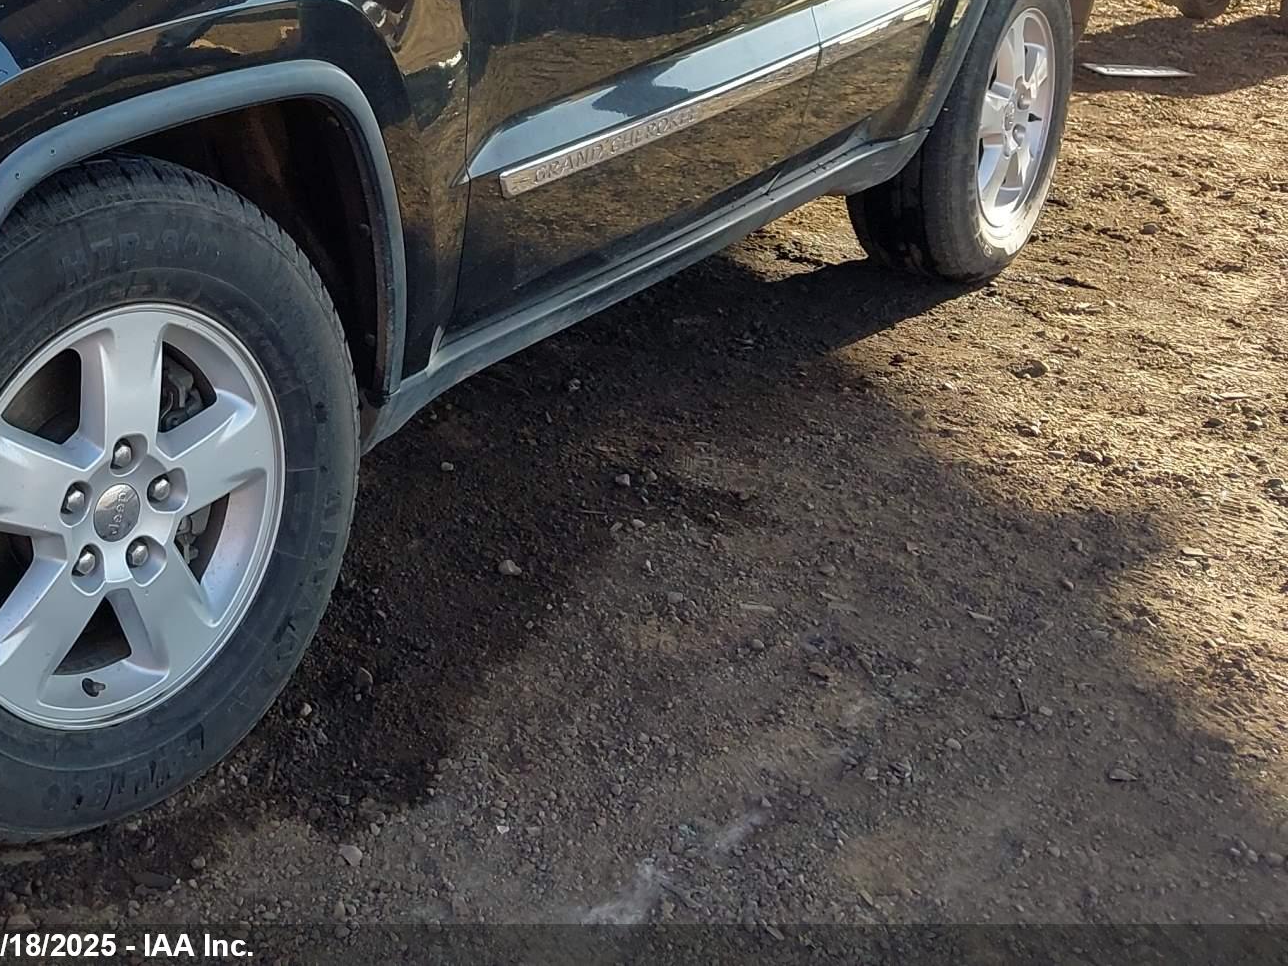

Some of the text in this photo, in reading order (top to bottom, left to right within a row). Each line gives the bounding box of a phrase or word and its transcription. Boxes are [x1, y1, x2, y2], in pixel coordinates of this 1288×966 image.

[534, 108, 699, 184] GRAND CHEROKEE
[108, 492, 129, 535] Jeep
